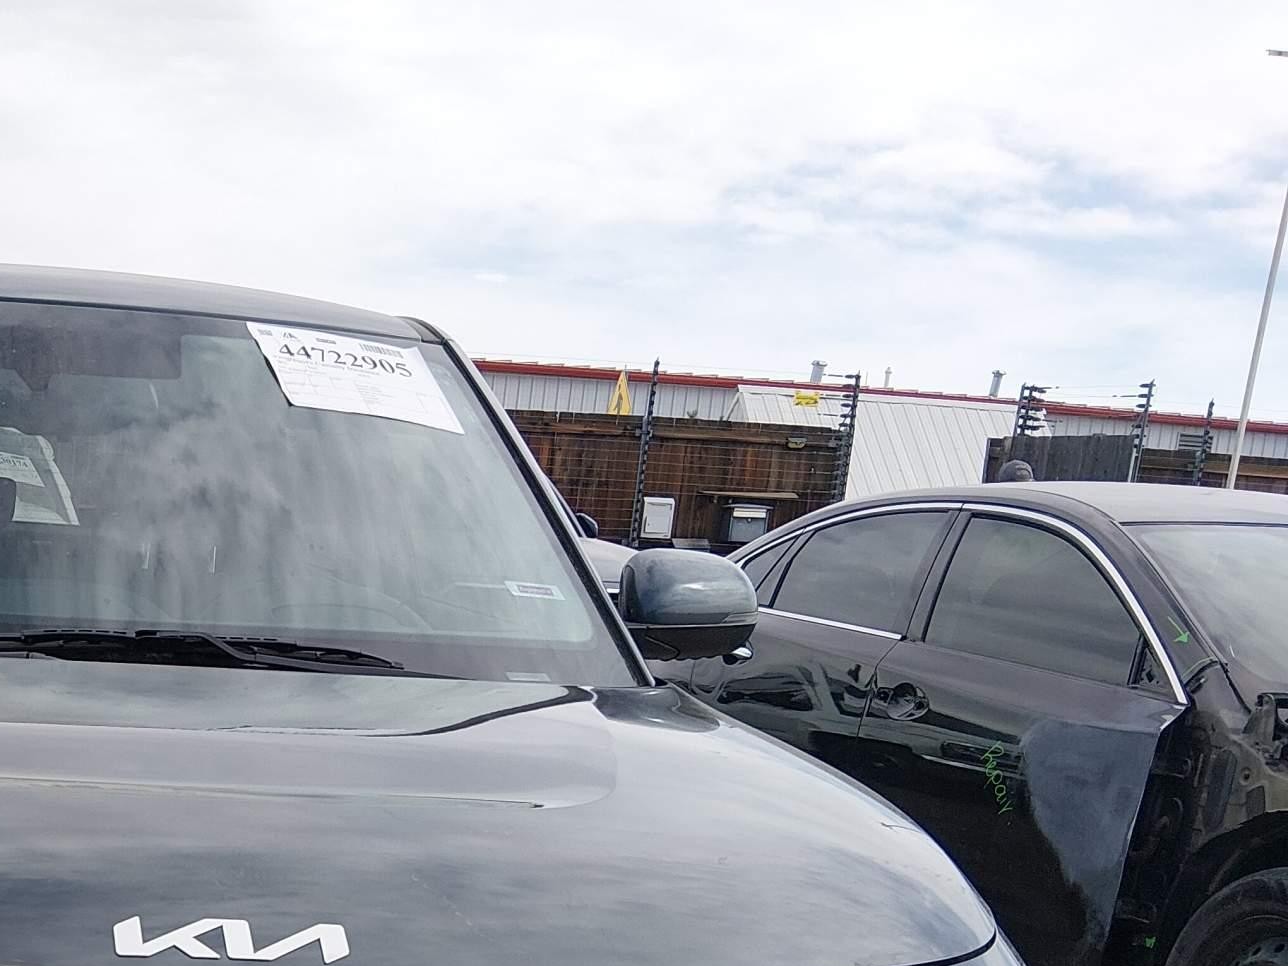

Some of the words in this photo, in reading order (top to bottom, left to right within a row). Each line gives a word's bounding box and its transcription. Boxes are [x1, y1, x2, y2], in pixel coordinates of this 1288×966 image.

[279, 343, 413, 378] 44722905
[980, 741, 1013, 815] Repair
[113, 915, 350, 965] KIA
